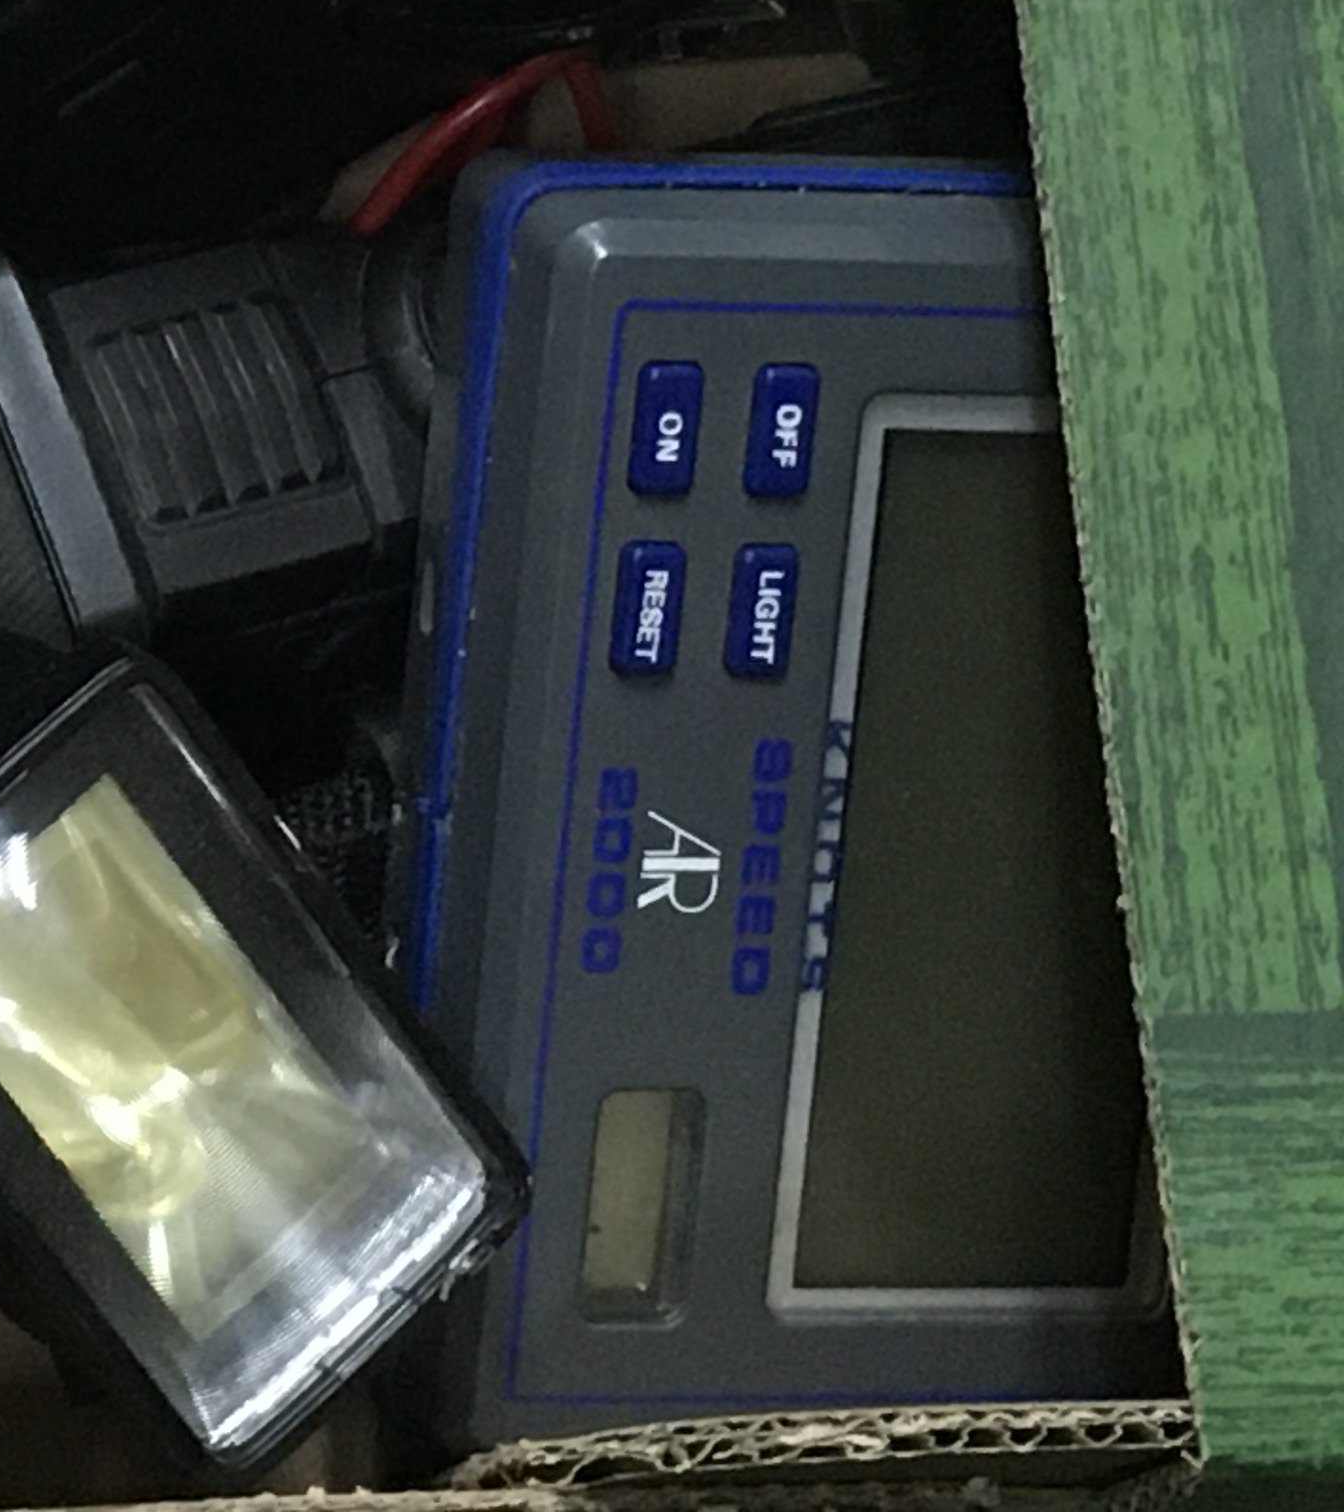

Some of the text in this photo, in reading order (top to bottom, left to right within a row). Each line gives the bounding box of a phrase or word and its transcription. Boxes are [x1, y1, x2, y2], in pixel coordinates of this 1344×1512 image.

[655, 411, 683, 462] ON
[772, 403, 803, 468] OFF
[635, 569, 669, 664] RESET
[750, 570, 785, 665] LIGHT
[579, 767, 638, 974] 2000
[730, 738, 793, 996] SPEED
